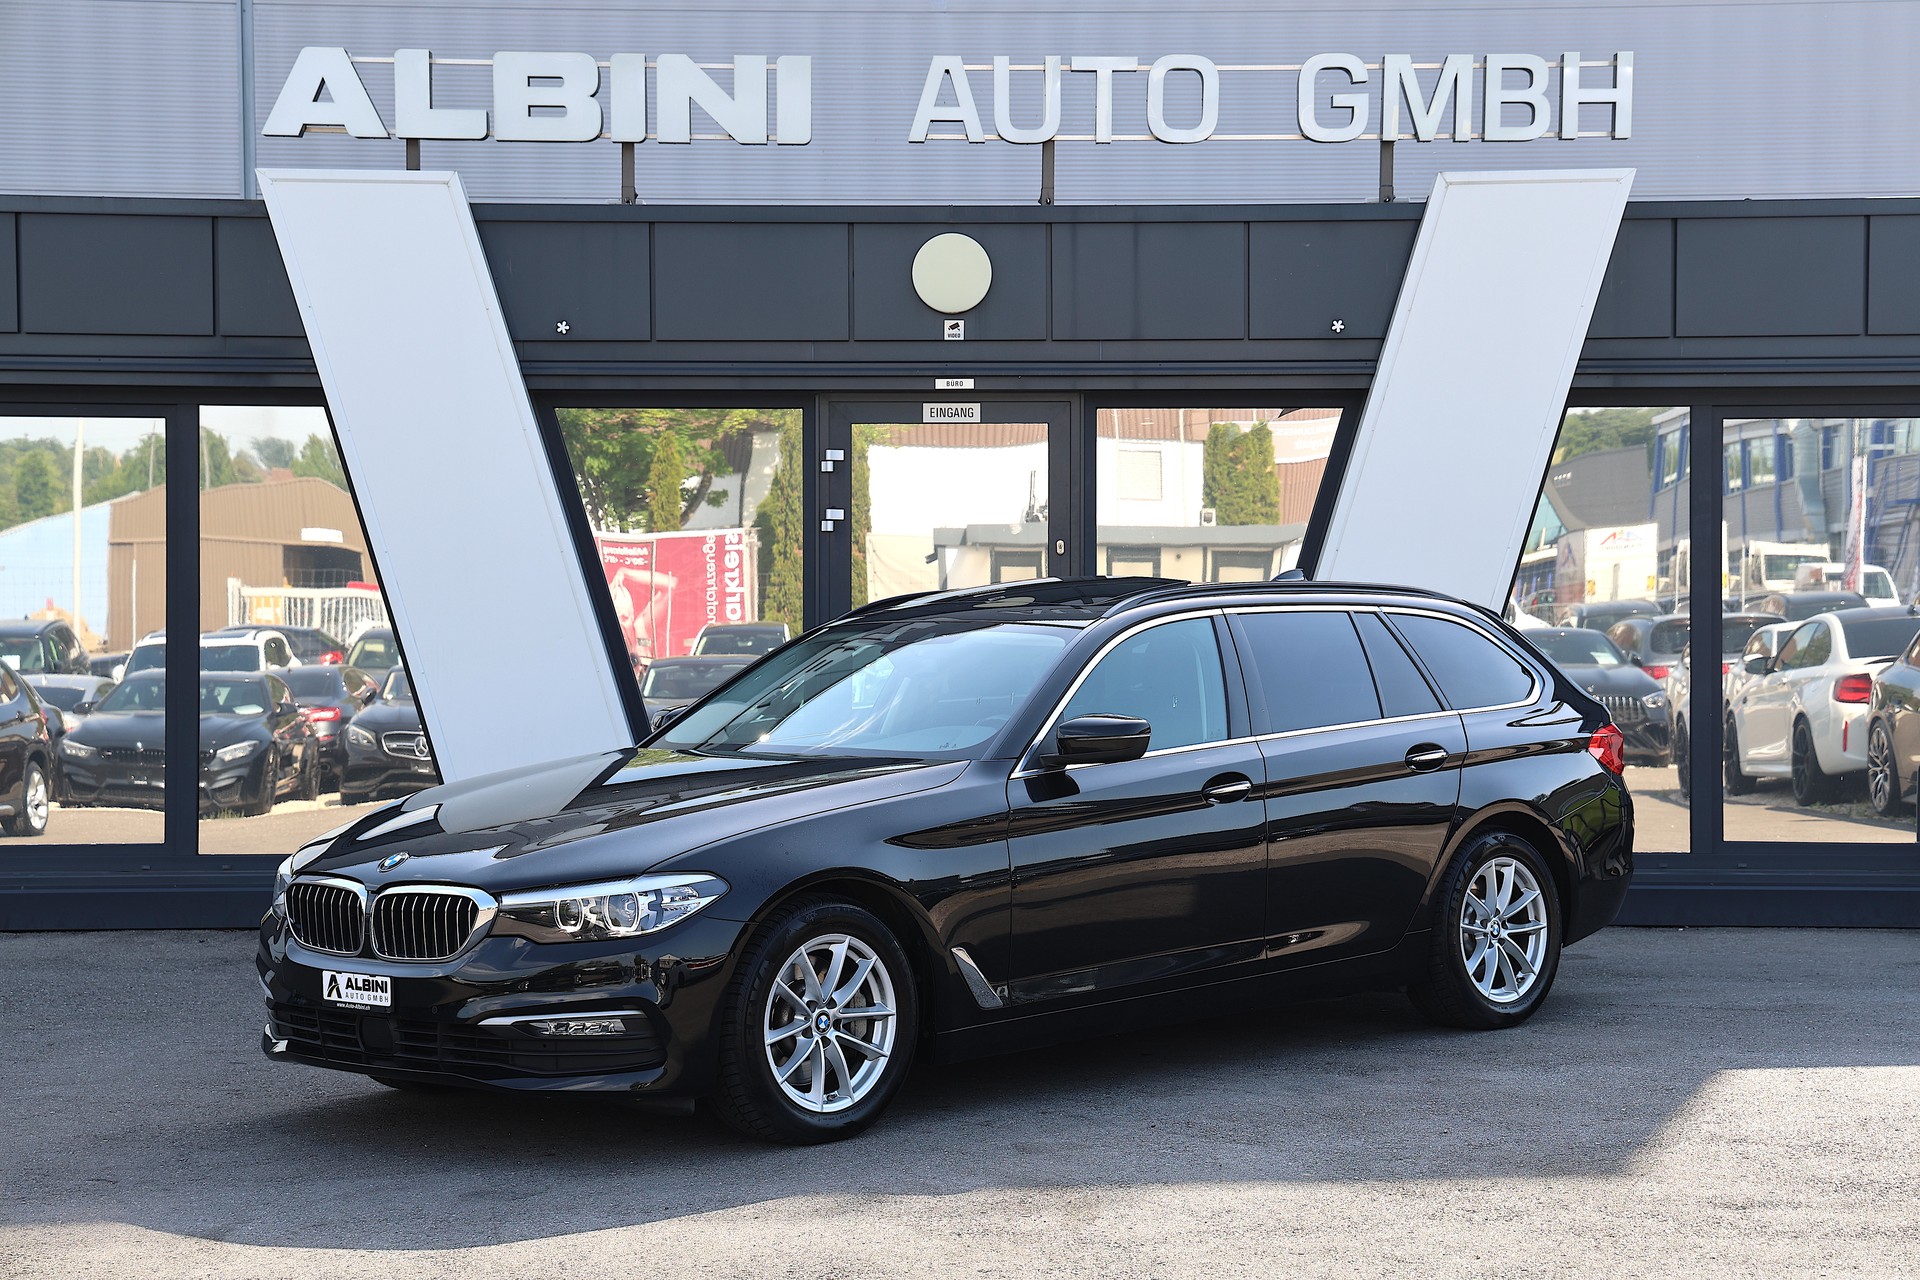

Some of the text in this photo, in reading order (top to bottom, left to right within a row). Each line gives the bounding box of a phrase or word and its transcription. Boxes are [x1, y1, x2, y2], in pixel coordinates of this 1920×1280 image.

[262, 46, 1635, 145] ALBINI AUTO GMBH
[946, 379, 964, 387] BÜRO
[929, 407, 975, 418] EINGANG
[345, 977, 388, 994] ALBINI
[345, 992, 389, 1003] AUTO GMBH
